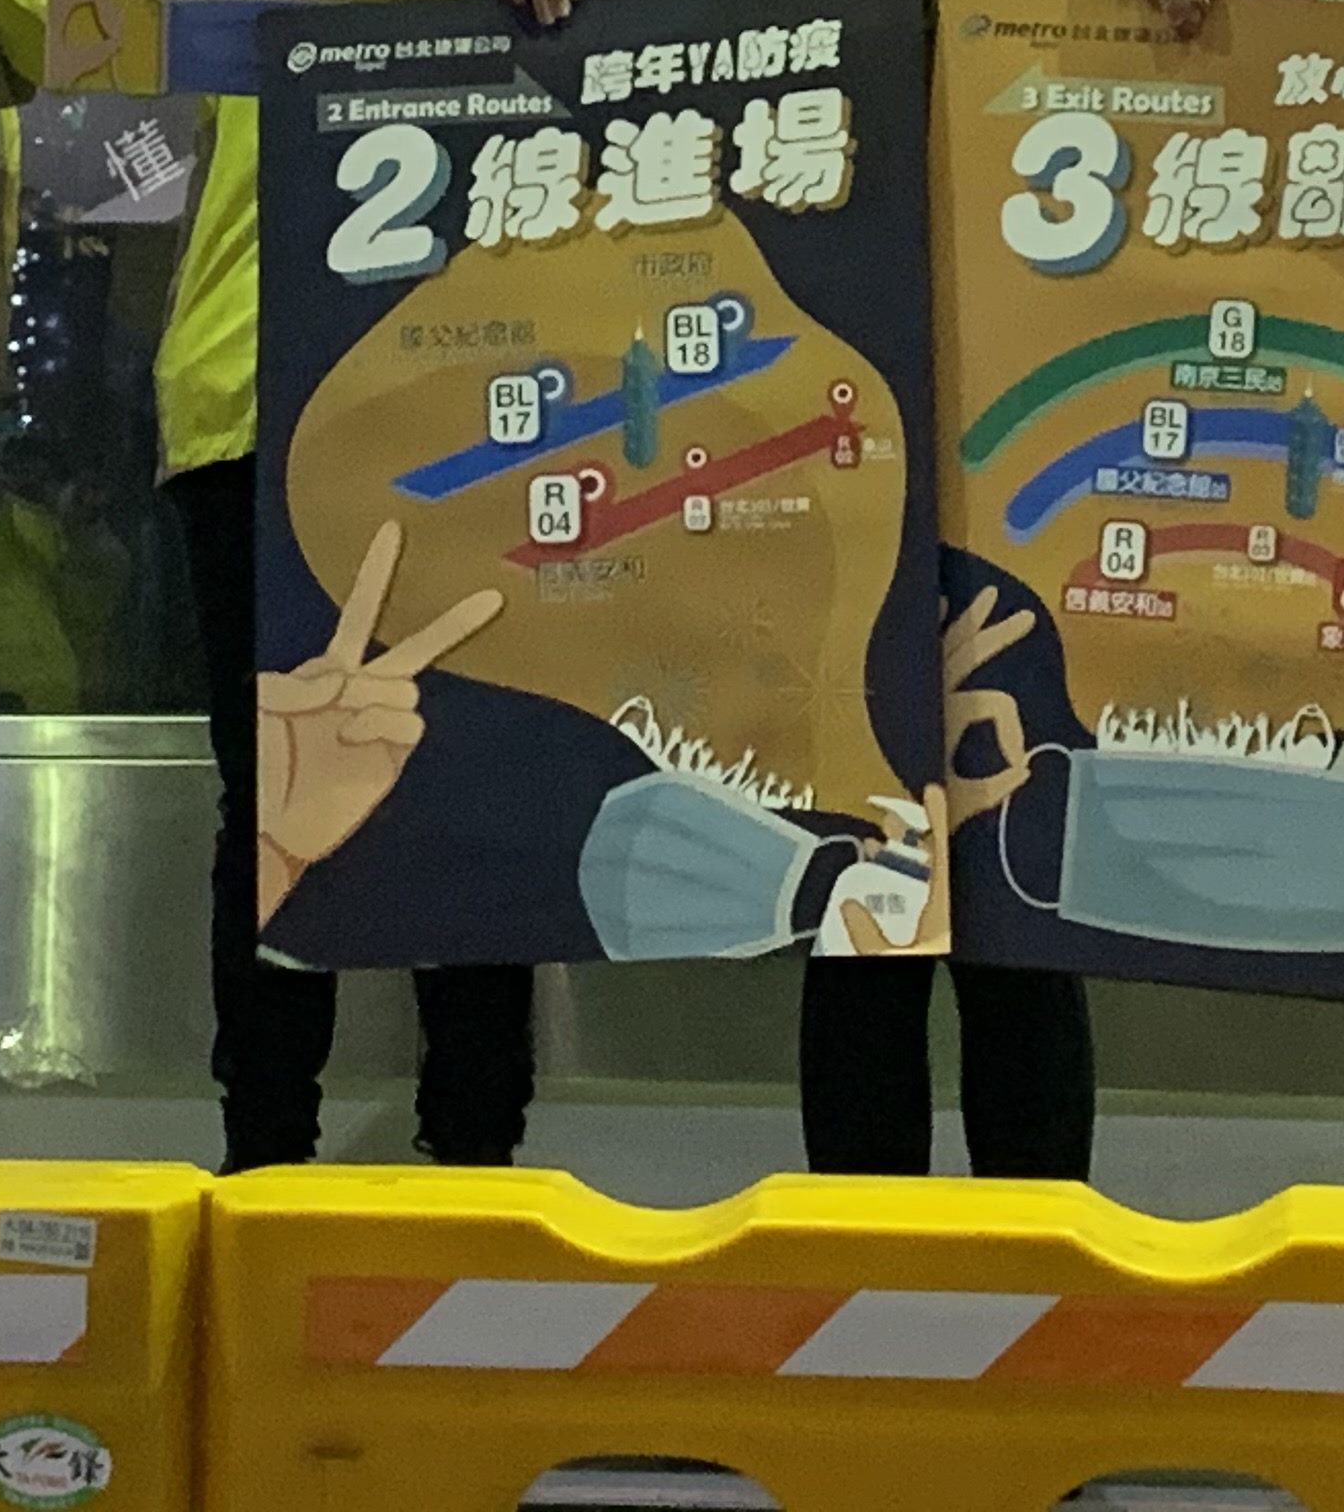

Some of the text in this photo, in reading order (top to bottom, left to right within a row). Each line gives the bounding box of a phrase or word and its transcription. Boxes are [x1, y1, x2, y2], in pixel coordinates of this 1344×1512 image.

[994, 21, 1067, 38] metro
[319, 41, 391, 63] metro
[327, 92, 552, 122] 2 Entrance Routes
[1021, 84, 1213, 115] 3 Exit Routes
[674, 314, 712, 338] BL
[1223, 307, 1243, 328] G
[1218, 331, 1246, 353] 18
[677, 343, 711, 366] 18
[496, 384, 533, 408] BL
[499, 412, 531, 436] 17
[1150, 407, 1183, 429] BL
[1151, 433, 1178, 451] 17
[545, 482, 566, 506] R
[537, 512, 572, 536] 04
[1115, 528, 1134, 549] R
[1107, 552, 1136, 574] 04
